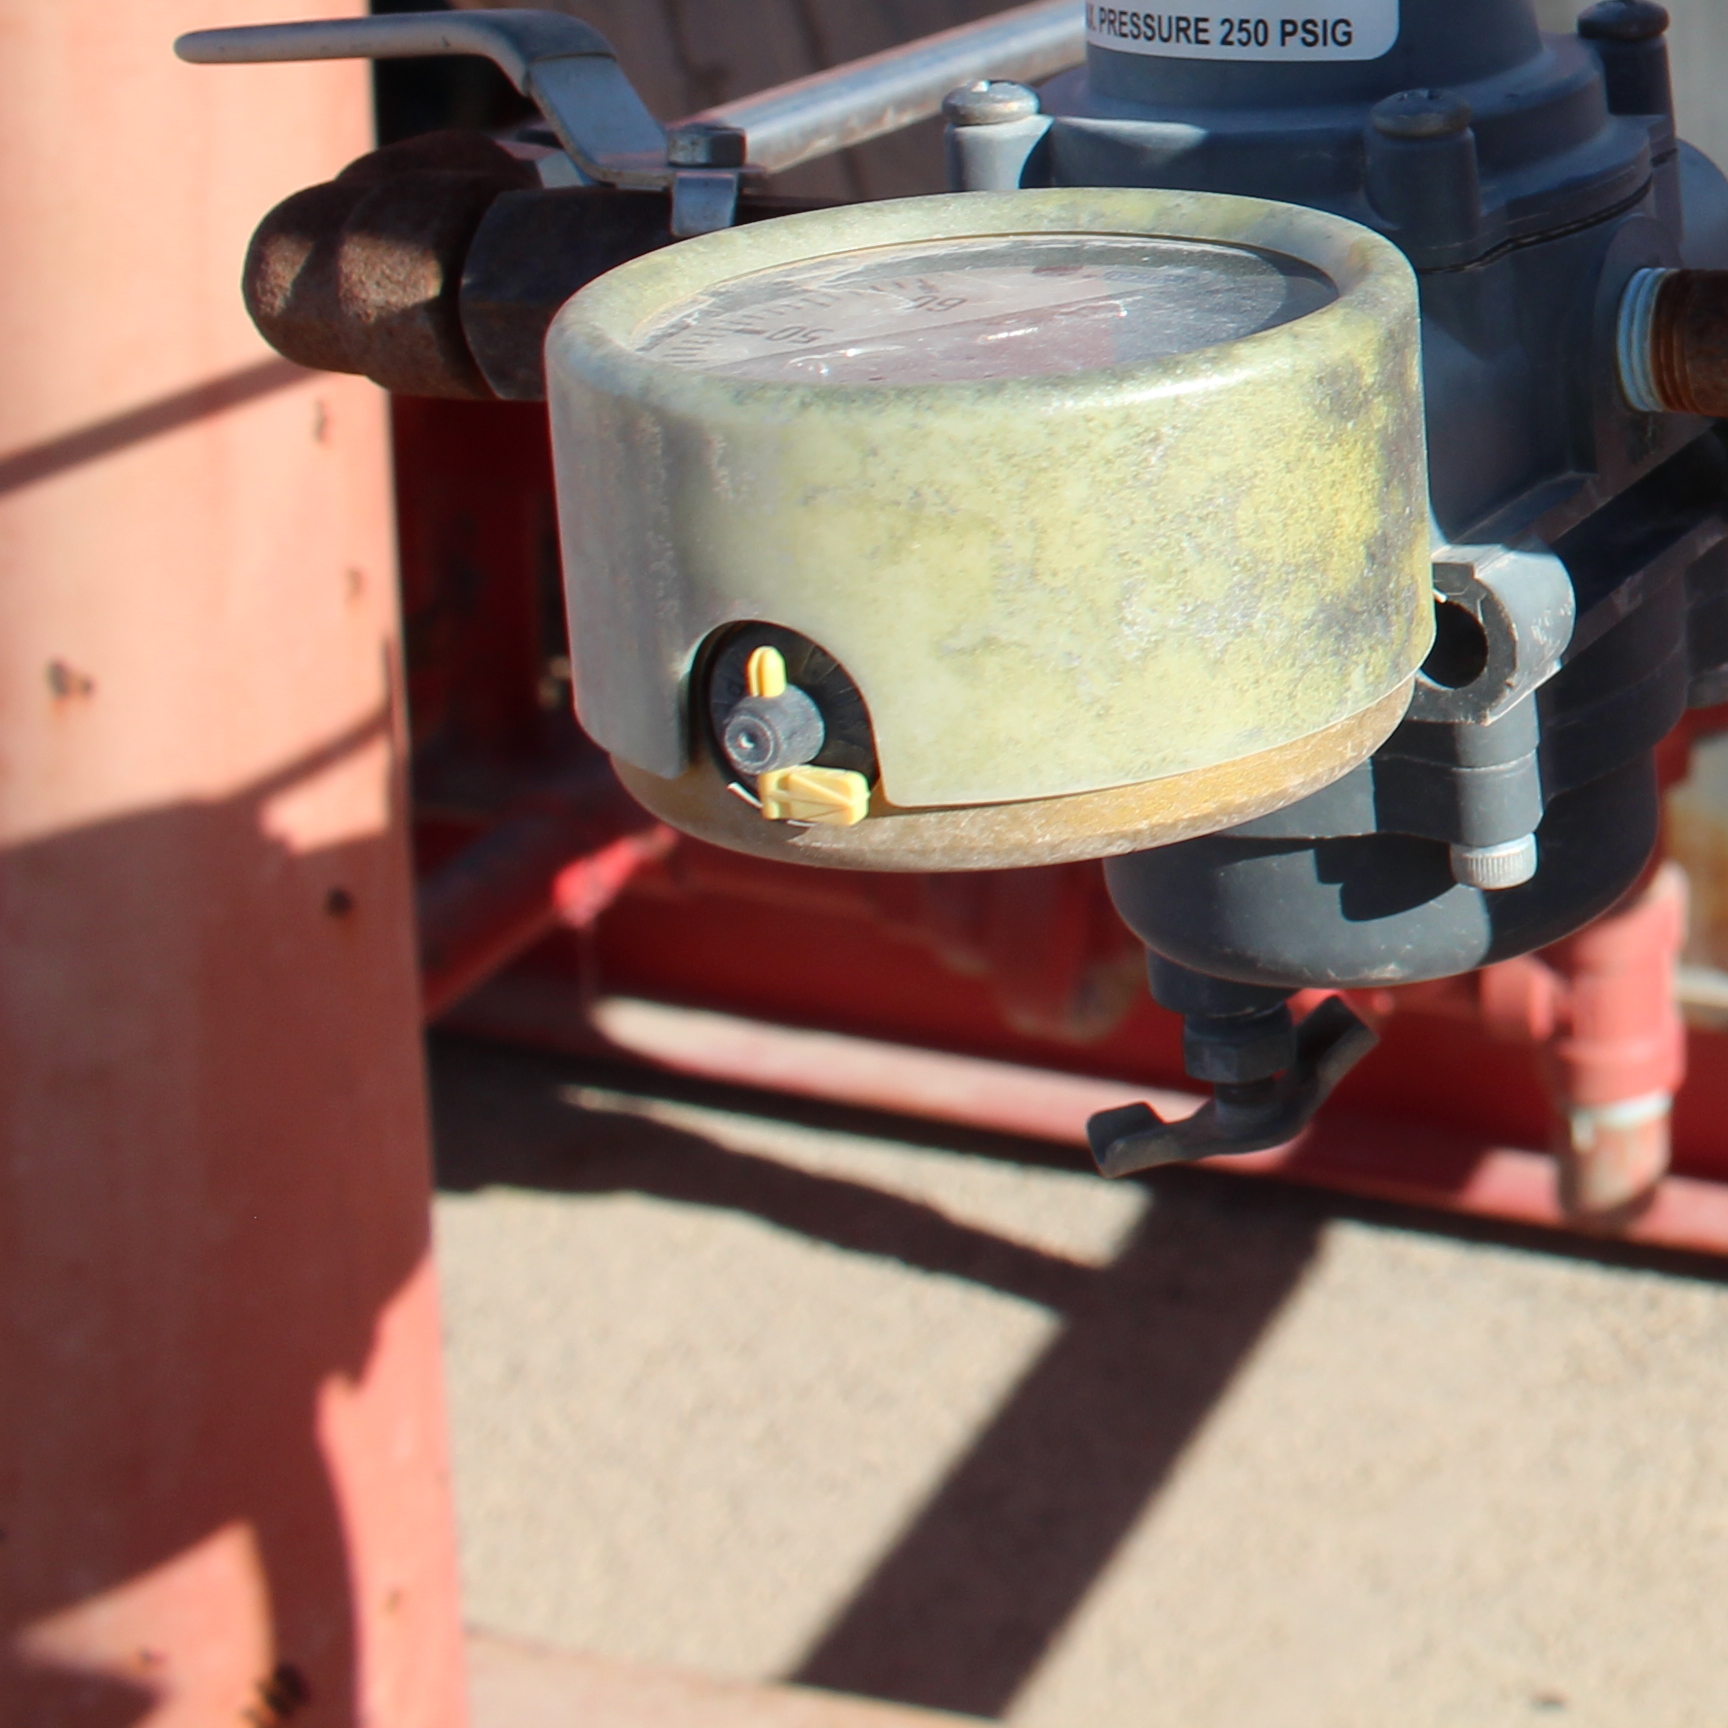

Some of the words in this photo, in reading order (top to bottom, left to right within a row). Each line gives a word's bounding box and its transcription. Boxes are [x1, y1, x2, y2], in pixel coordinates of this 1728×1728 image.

[1098, 6, 1211, 46] PRESSURE
[1219, 18, 1270, 47] 250
[1280, 18, 1354, 47] PSIG
